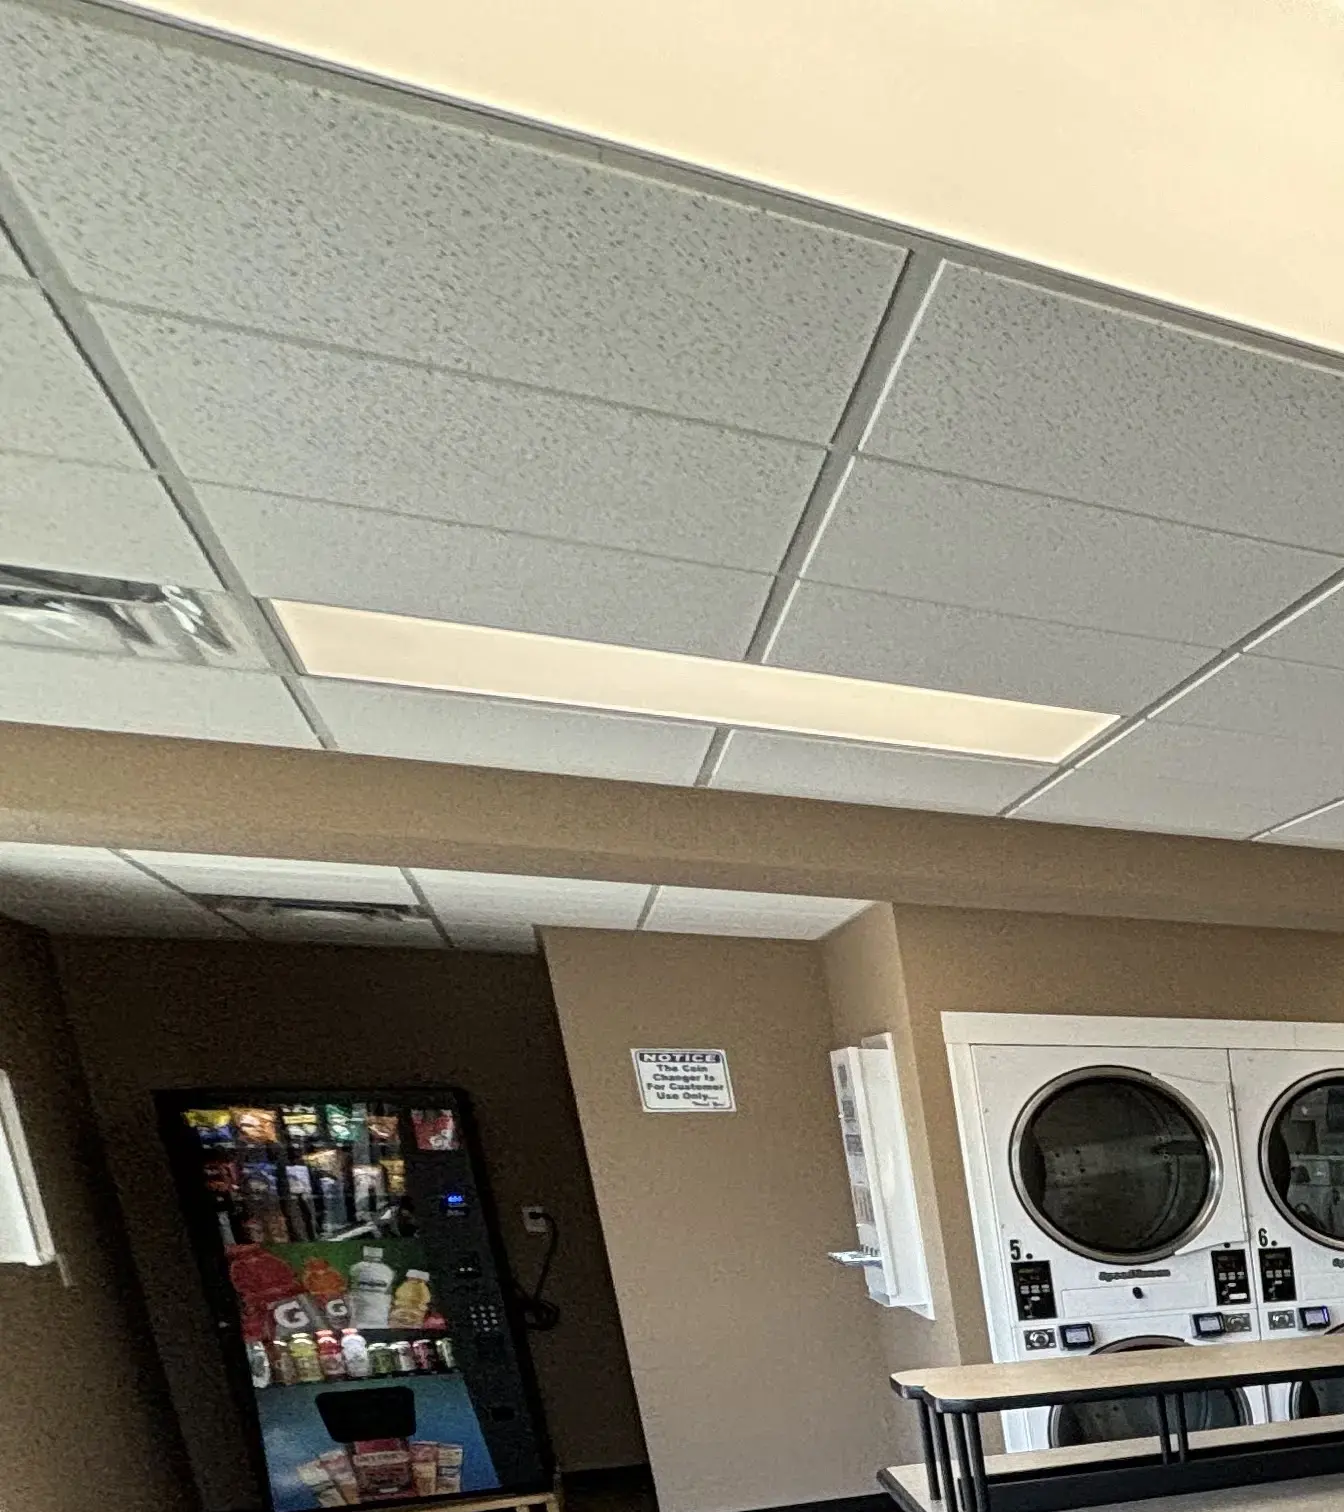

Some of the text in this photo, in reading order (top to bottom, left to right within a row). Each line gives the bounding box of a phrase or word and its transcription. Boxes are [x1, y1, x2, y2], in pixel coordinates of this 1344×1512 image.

[643, 1054, 717, 1062] NOTICE
[656, 1064, 708, 1072] The Coin
[652, 1073, 701, 1083] Changer
[646, 1083, 724, 1091] For Customer
[656, 1092, 679, 1100] Use
[327, 1299, 348, 1317] G
[274, 1300, 310, 1329] G
